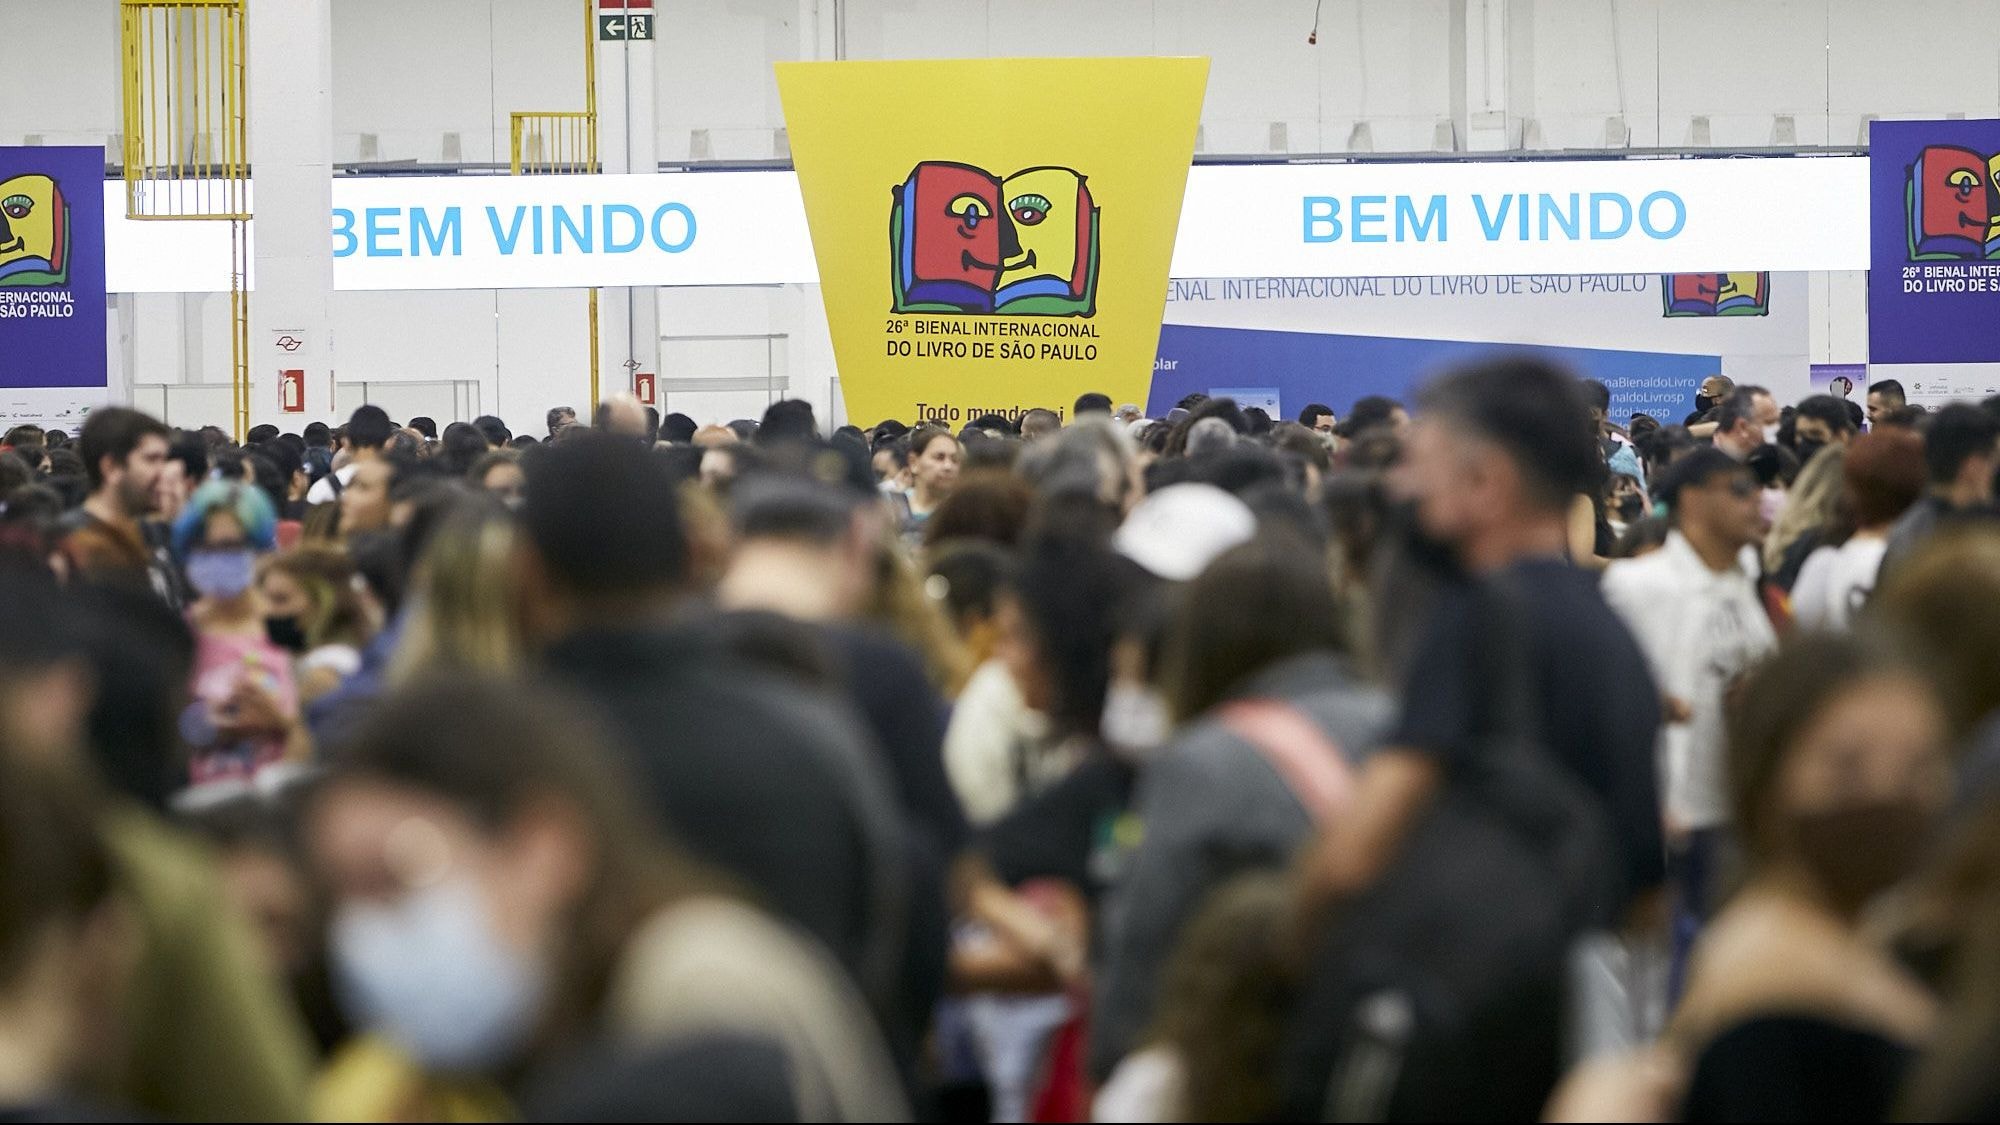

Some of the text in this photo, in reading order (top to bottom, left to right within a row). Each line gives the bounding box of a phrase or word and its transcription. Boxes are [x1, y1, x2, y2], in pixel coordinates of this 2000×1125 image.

[1303, 190, 1687, 243] BEM VINDO
[331, 203, 697, 257] BEM VINDO
[1902, 266, 1921, 279] 26ª
[1924, 266, 1969, 278] BIENAL
[1223, 277, 1386, 299] INTERNACIONAL
[1393, 276, 1422, 296] DO
[1430, 275, 1488, 295] LIVRO
[1496, 275, 1522, 294] DE
[1580, 273, 1647, 293] PAULO
[1903, 279, 1923, 293] DO
[1926, 279, 1966, 293] LIVRO
[1968, 278, 1987, 292] DE
[0, 303, 73, 318] SÃO PAULO
[886, 319, 1100, 338] 26ª BIENAL INTERNACIONAL
[887, 340, 1097, 361] DO LIVRO DE SÃO PAULO
[916, 403, 960, 421] Todo
